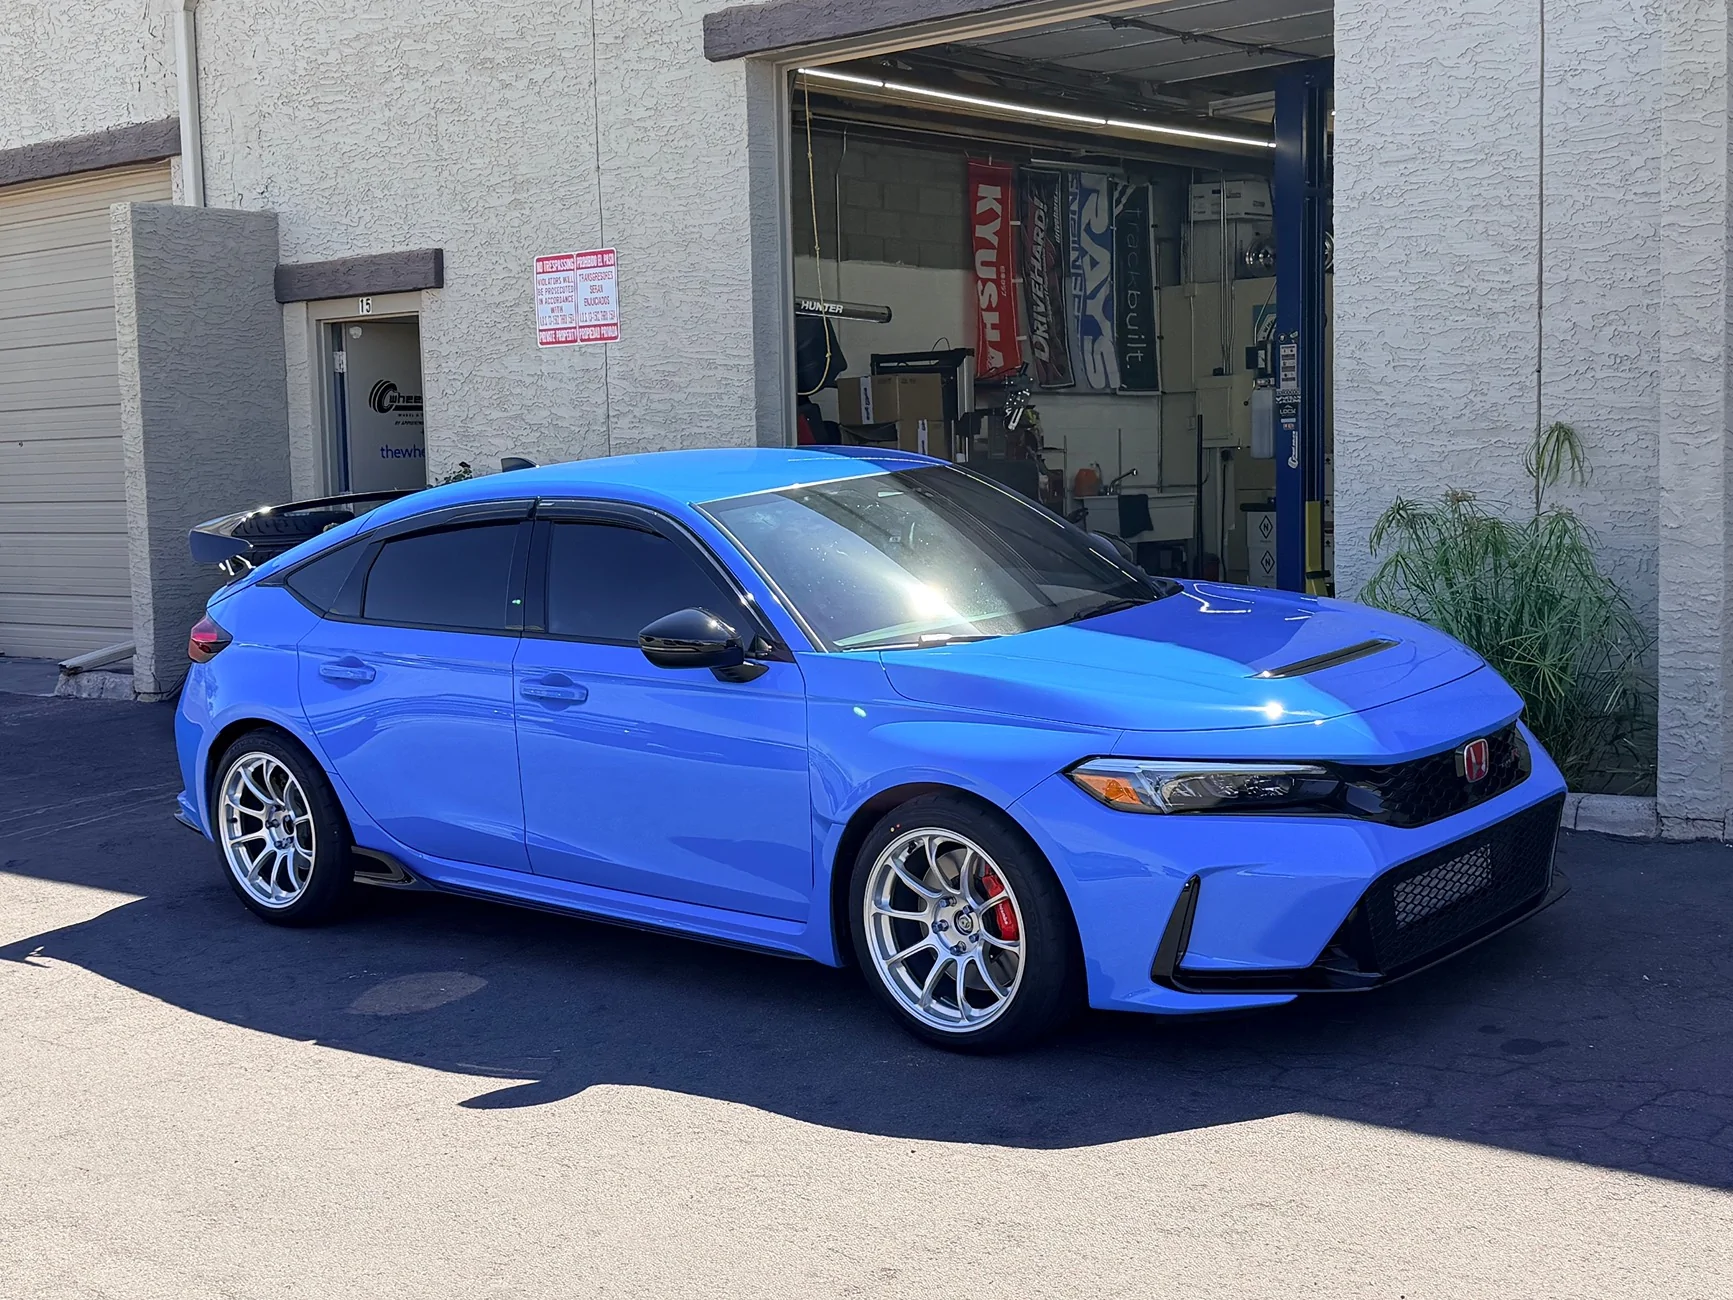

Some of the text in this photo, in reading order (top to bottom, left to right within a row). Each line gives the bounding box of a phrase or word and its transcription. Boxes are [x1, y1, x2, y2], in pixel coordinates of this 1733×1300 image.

[544, 259, 574, 272] TRESPASSING
[538, 275, 574, 286] VIOLATORS WILL
[974, 184, 1004, 370] KYUSHA
[1081, 172, 1121, 389] RAYS
[537, 285, 574, 296] BE PROSECUTED
[360, 298, 371, 313] 15
[544, 295, 574, 304] ACCORDANCE
[801, 300, 844, 314] HUNTER
